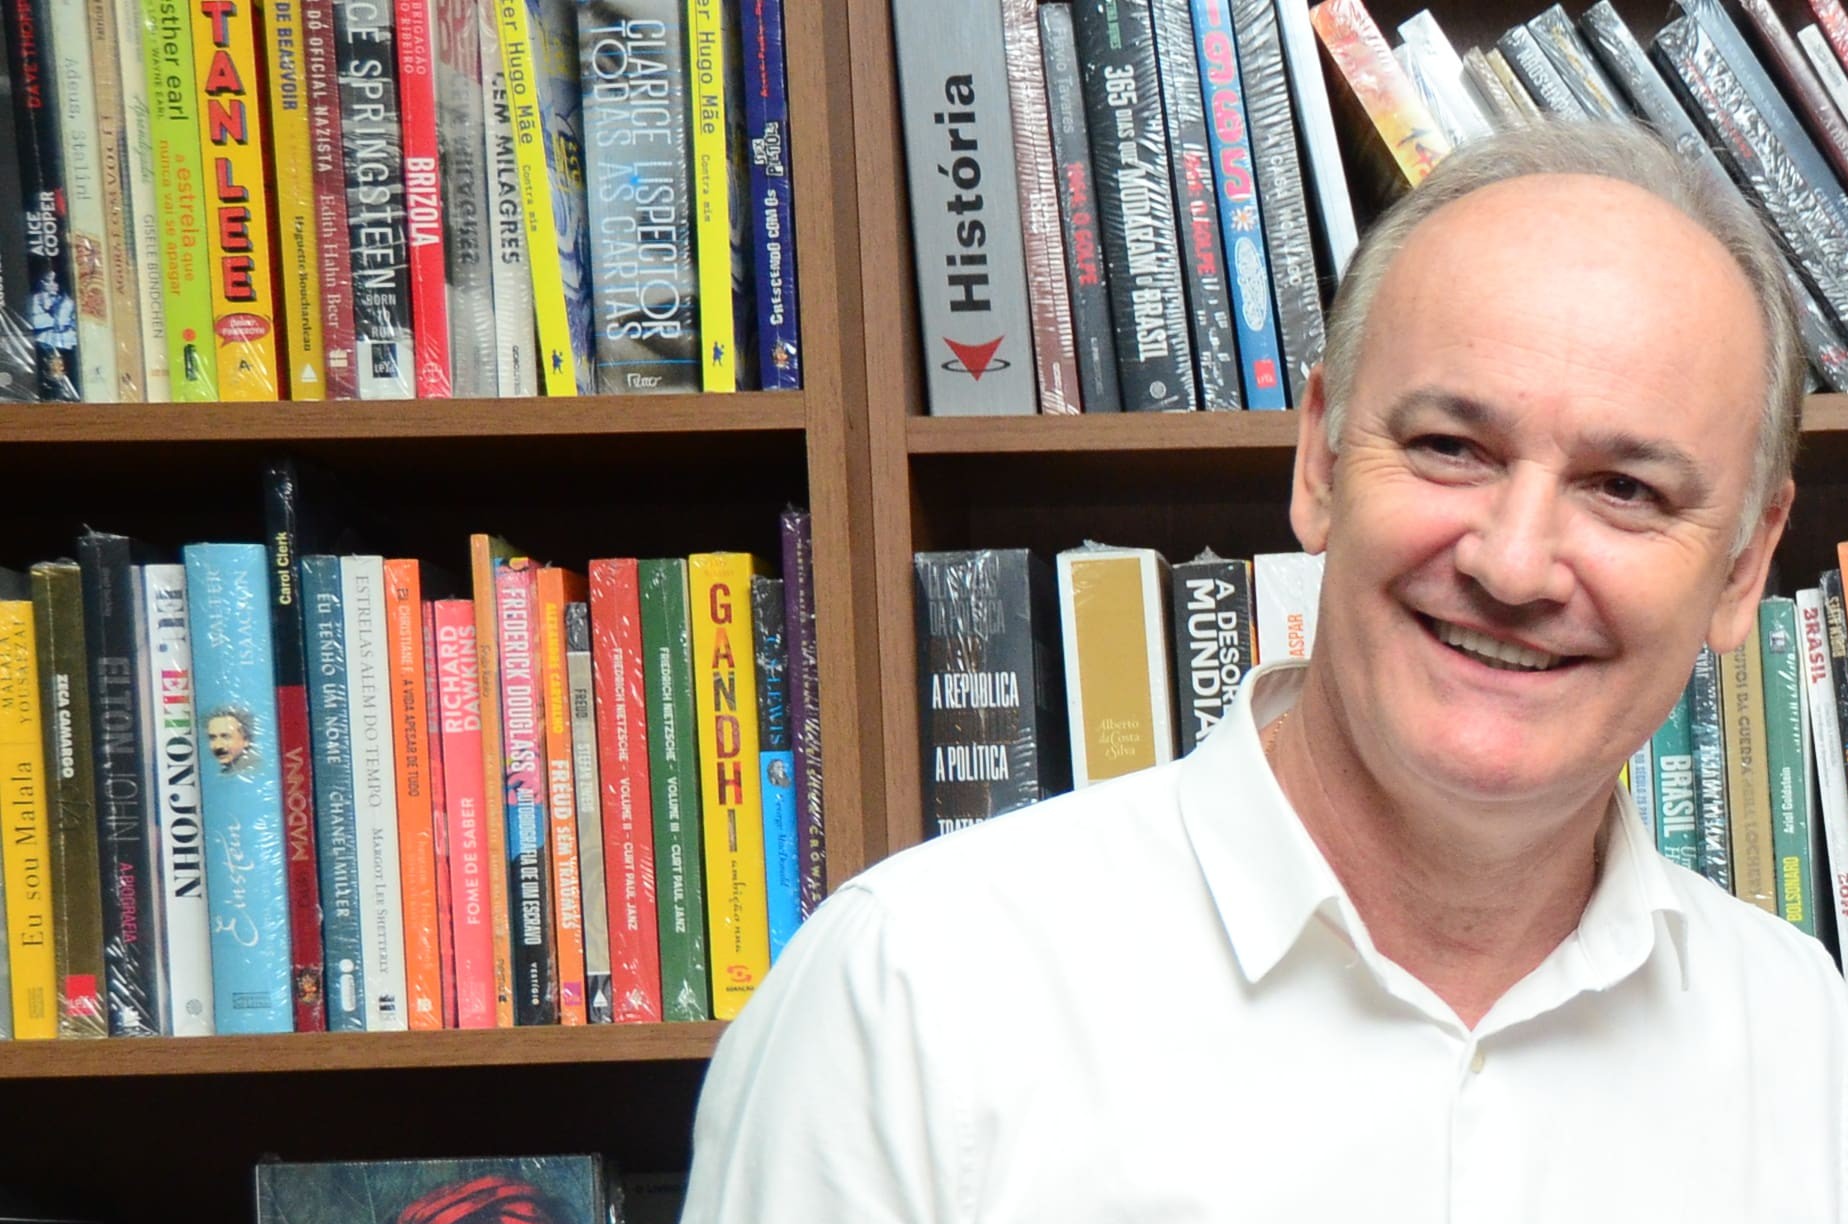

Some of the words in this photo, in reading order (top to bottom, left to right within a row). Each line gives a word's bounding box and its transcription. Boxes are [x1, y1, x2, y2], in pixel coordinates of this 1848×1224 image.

[275, 2, 291, 24] DE
[276, 29, 300, 111] BEAUVOIR
[507, 41, 527, 95] Hugo
[590, 20, 632, 147] TODAS
[625, 19, 672, 145] CLARICE
[697, 31, 717, 84] Hugo
[516, 104, 535, 145] Mãe
[701, 94, 719, 135] Mãe
[405, 156, 440, 248] BRIZOLA
[598, 162, 635, 202] AS
[935, 74, 992, 313] História
[26, 208, 44, 256] ALICE
[42, 191, 59, 257] COOPER
[319, 193, 334, 241] Edith
[323, 246, 338, 288] Hahn
[600, 215, 643, 341] CARTAS
[632, 161, 681, 341] LISPECTOR
[326, 295, 340, 331] Beer
[275, 531, 288, 562] Clerk
[279, 565, 291, 606] Carol
[501, 587, 531, 679] FREDERICK
[1802, 607, 1826, 684] BRASIL
[55, 675, 70, 707] ZECA
[438, 625, 462, 733] RICHARD
[458, 624, 482, 731] DAWKINS
[659, 647, 673, 704] FRIEDRICH
[932, 674, 943, 709] A
[59, 711, 75, 778] CAMARGO
[161, 668, 197, 788] ELTON
[507, 686, 535, 774] DOUGLASS
[662, 706, 676, 764] NIETZSCHE
[709, 584, 745, 852] GANDHI
[936, 747, 946, 781] A
[947, 743, 1009, 781] POLÍTICA
[14, 761, 37, 849] Malala
[285, 745, 310, 862] MADONNA
[549, 760, 570, 821] FREUD
[668, 777, 680, 816] VOLUME
[1660, 755, 1695, 837] BRASIL
[170, 794, 203, 900] JOHN
[460, 797, 478, 848] SABER
[515, 787, 538, 864] AUTOBIOGRAFIA
[555, 827, 570, 855] SEM
[20, 861, 41, 899] sou
[215, 813, 258, 948] Einstein
[464, 855, 478, 872] DE
[520, 867, 538, 880] DE
[671, 845, 683, 873] CURT
[465, 876, 481, 925] FOME
[521, 882, 540, 900] UM
[557, 860, 579, 930] TRAUMAS
[674, 876, 686, 902] PAUL
[1784, 855, 1802, 922] BOLSONARO
[22, 913, 44, 948] Eu
[522, 901, 543, 945] ESCRAVO
[676, 905, 687, 933] JANZ
